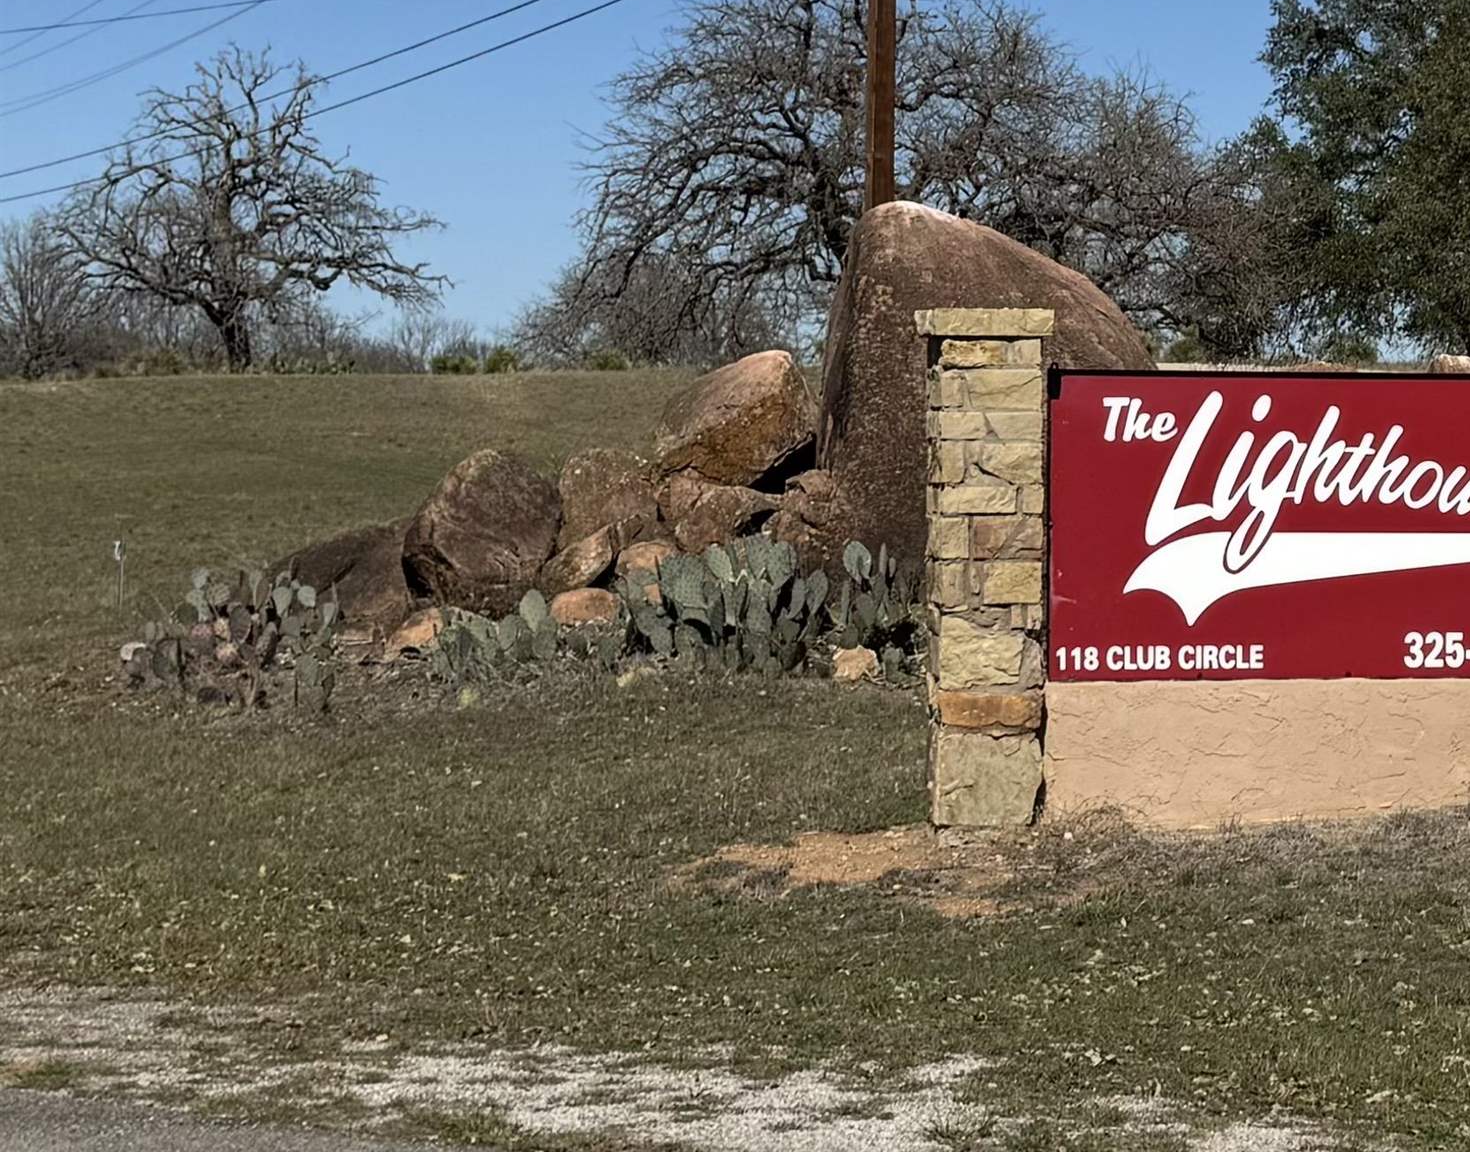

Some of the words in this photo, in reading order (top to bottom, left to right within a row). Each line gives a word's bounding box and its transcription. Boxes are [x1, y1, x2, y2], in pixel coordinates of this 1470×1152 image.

[1102, 396, 1179, 443] The
[1055, 646, 1100, 671] 118
[1105, 645, 1172, 671] CLUB
[1177, 644, 1264, 671] CIRCLE
